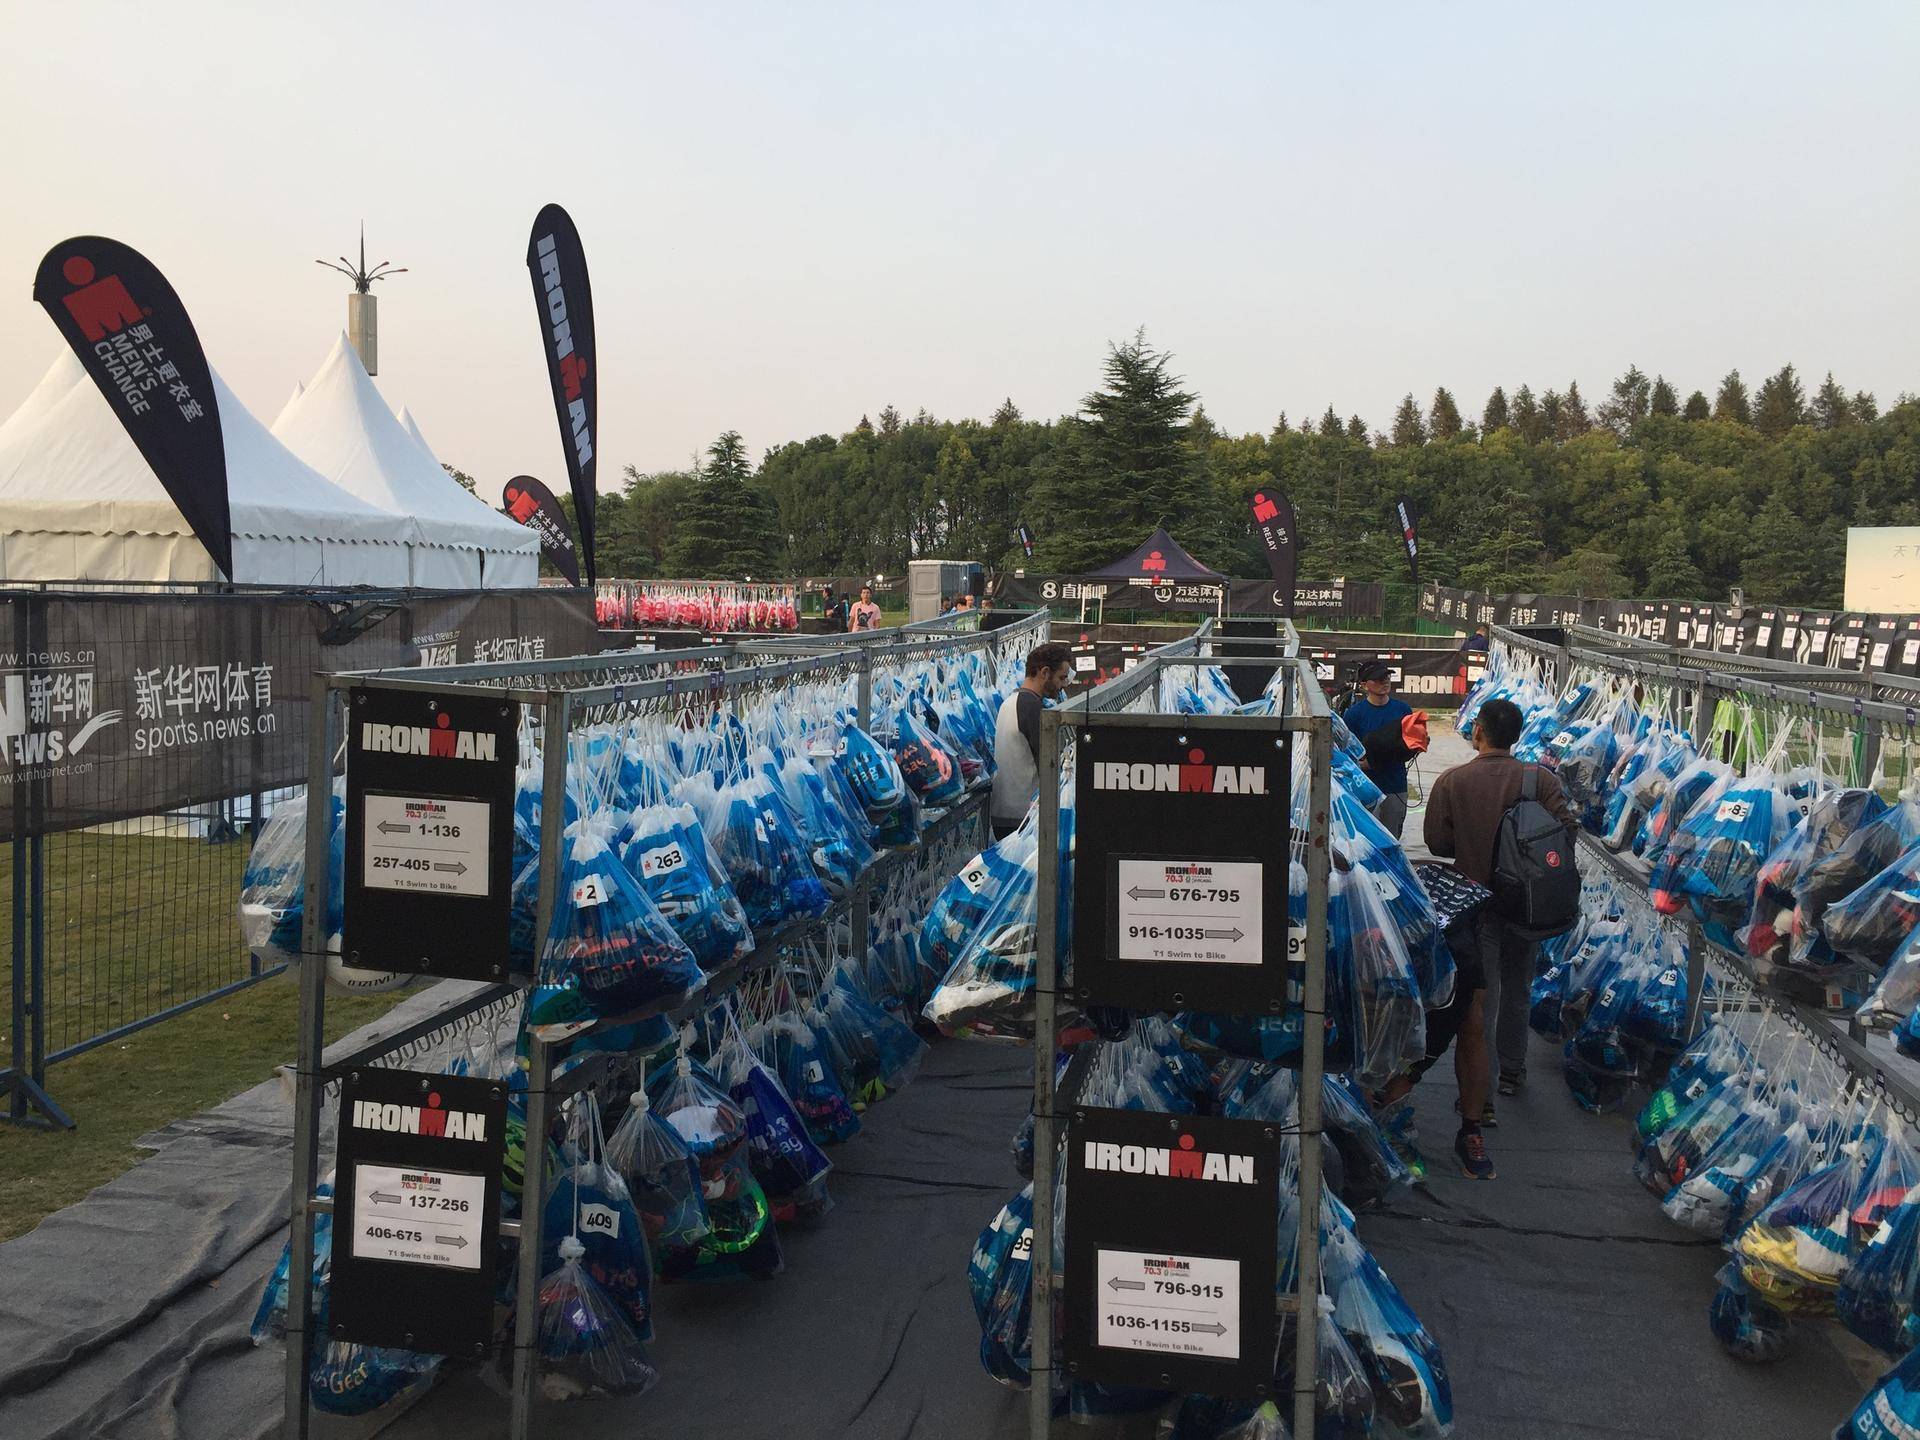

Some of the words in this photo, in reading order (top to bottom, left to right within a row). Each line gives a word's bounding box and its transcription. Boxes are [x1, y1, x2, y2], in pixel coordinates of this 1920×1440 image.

[537, 233, 592, 469] IRONMAN
[111, 333, 158, 392] MEN'S
[95, 341, 150, 416] CHANGE
[129, 324, 203, 422] 男士更衣室
[1262, 526, 1277, 552] RELAY
[1293, 600, 1317, 608] WANDA
[1318, 600, 1342, 608] SPORTS
[29, 672, 94, 724] 新华网
[133, 661, 274, 720] 新华网体育
[134, 711, 276, 756] sports.news.cn
[362, 713, 496, 762] IRONMAN
[1093, 748, 1265, 795] IRONMAN
[405, 801, 447, 813] IRONMAN
[405, 811, 421, 819] 70.3
[418, 823, 461, 838] 1-136
[373, 856, 430, 871] 257-405
[654, 850, 682, 869] 263
[1165, 863, 1212, 875] IRONMAN
[406, 880, 428, 889] Swim
[430, 882, 439, 890] to
[440, 881, 458, 891] Bike
[1165, 874, 1184, 883] 70.3
[586, 885, 597, 899] 2
[1169, 888, 1240, 903] 676-795
[1129, 925, 1204, 940] 916-1035
[1153, 950, 1164, 958] T1
[1167, 950, 1192, 959] Swim
[1194, 951, 1203, 959] to
[1205, 951, 1226, 960] Bike
[352, 1092, 486, 1142] IRONMAN
[1084, 1134, 1255, 1184] IRONMAN
[401, 1173, 442, 1185] IRONMAN
[401, 1181, 417, 1190] 70.3
[409, 1195, 469, 1212] 137-256
[587, 1212, 612, 1229] 409
[366, 1226, 423, 1242] 406-675
[388, 1249, 398, 1257] T1
[400, 1250, 421, 1260] Swim
[433, 1253, 450, 1262] Bike
[1143, 1257, 1190, 1270] IRONMAN
[1143, 1266, 1162, 1276] 70.3
[1154, 1280, 1224, 1299] 796-915
[1106, 1314, 1191, 1334] 1036-1155
[1132, 1339, 1143, 1347] T1
[1146, 1340, 1170, 1350] Swim
[1172, 1342, 1182, 1350] to
[1183, 1343, 1204, 1352] Bike
